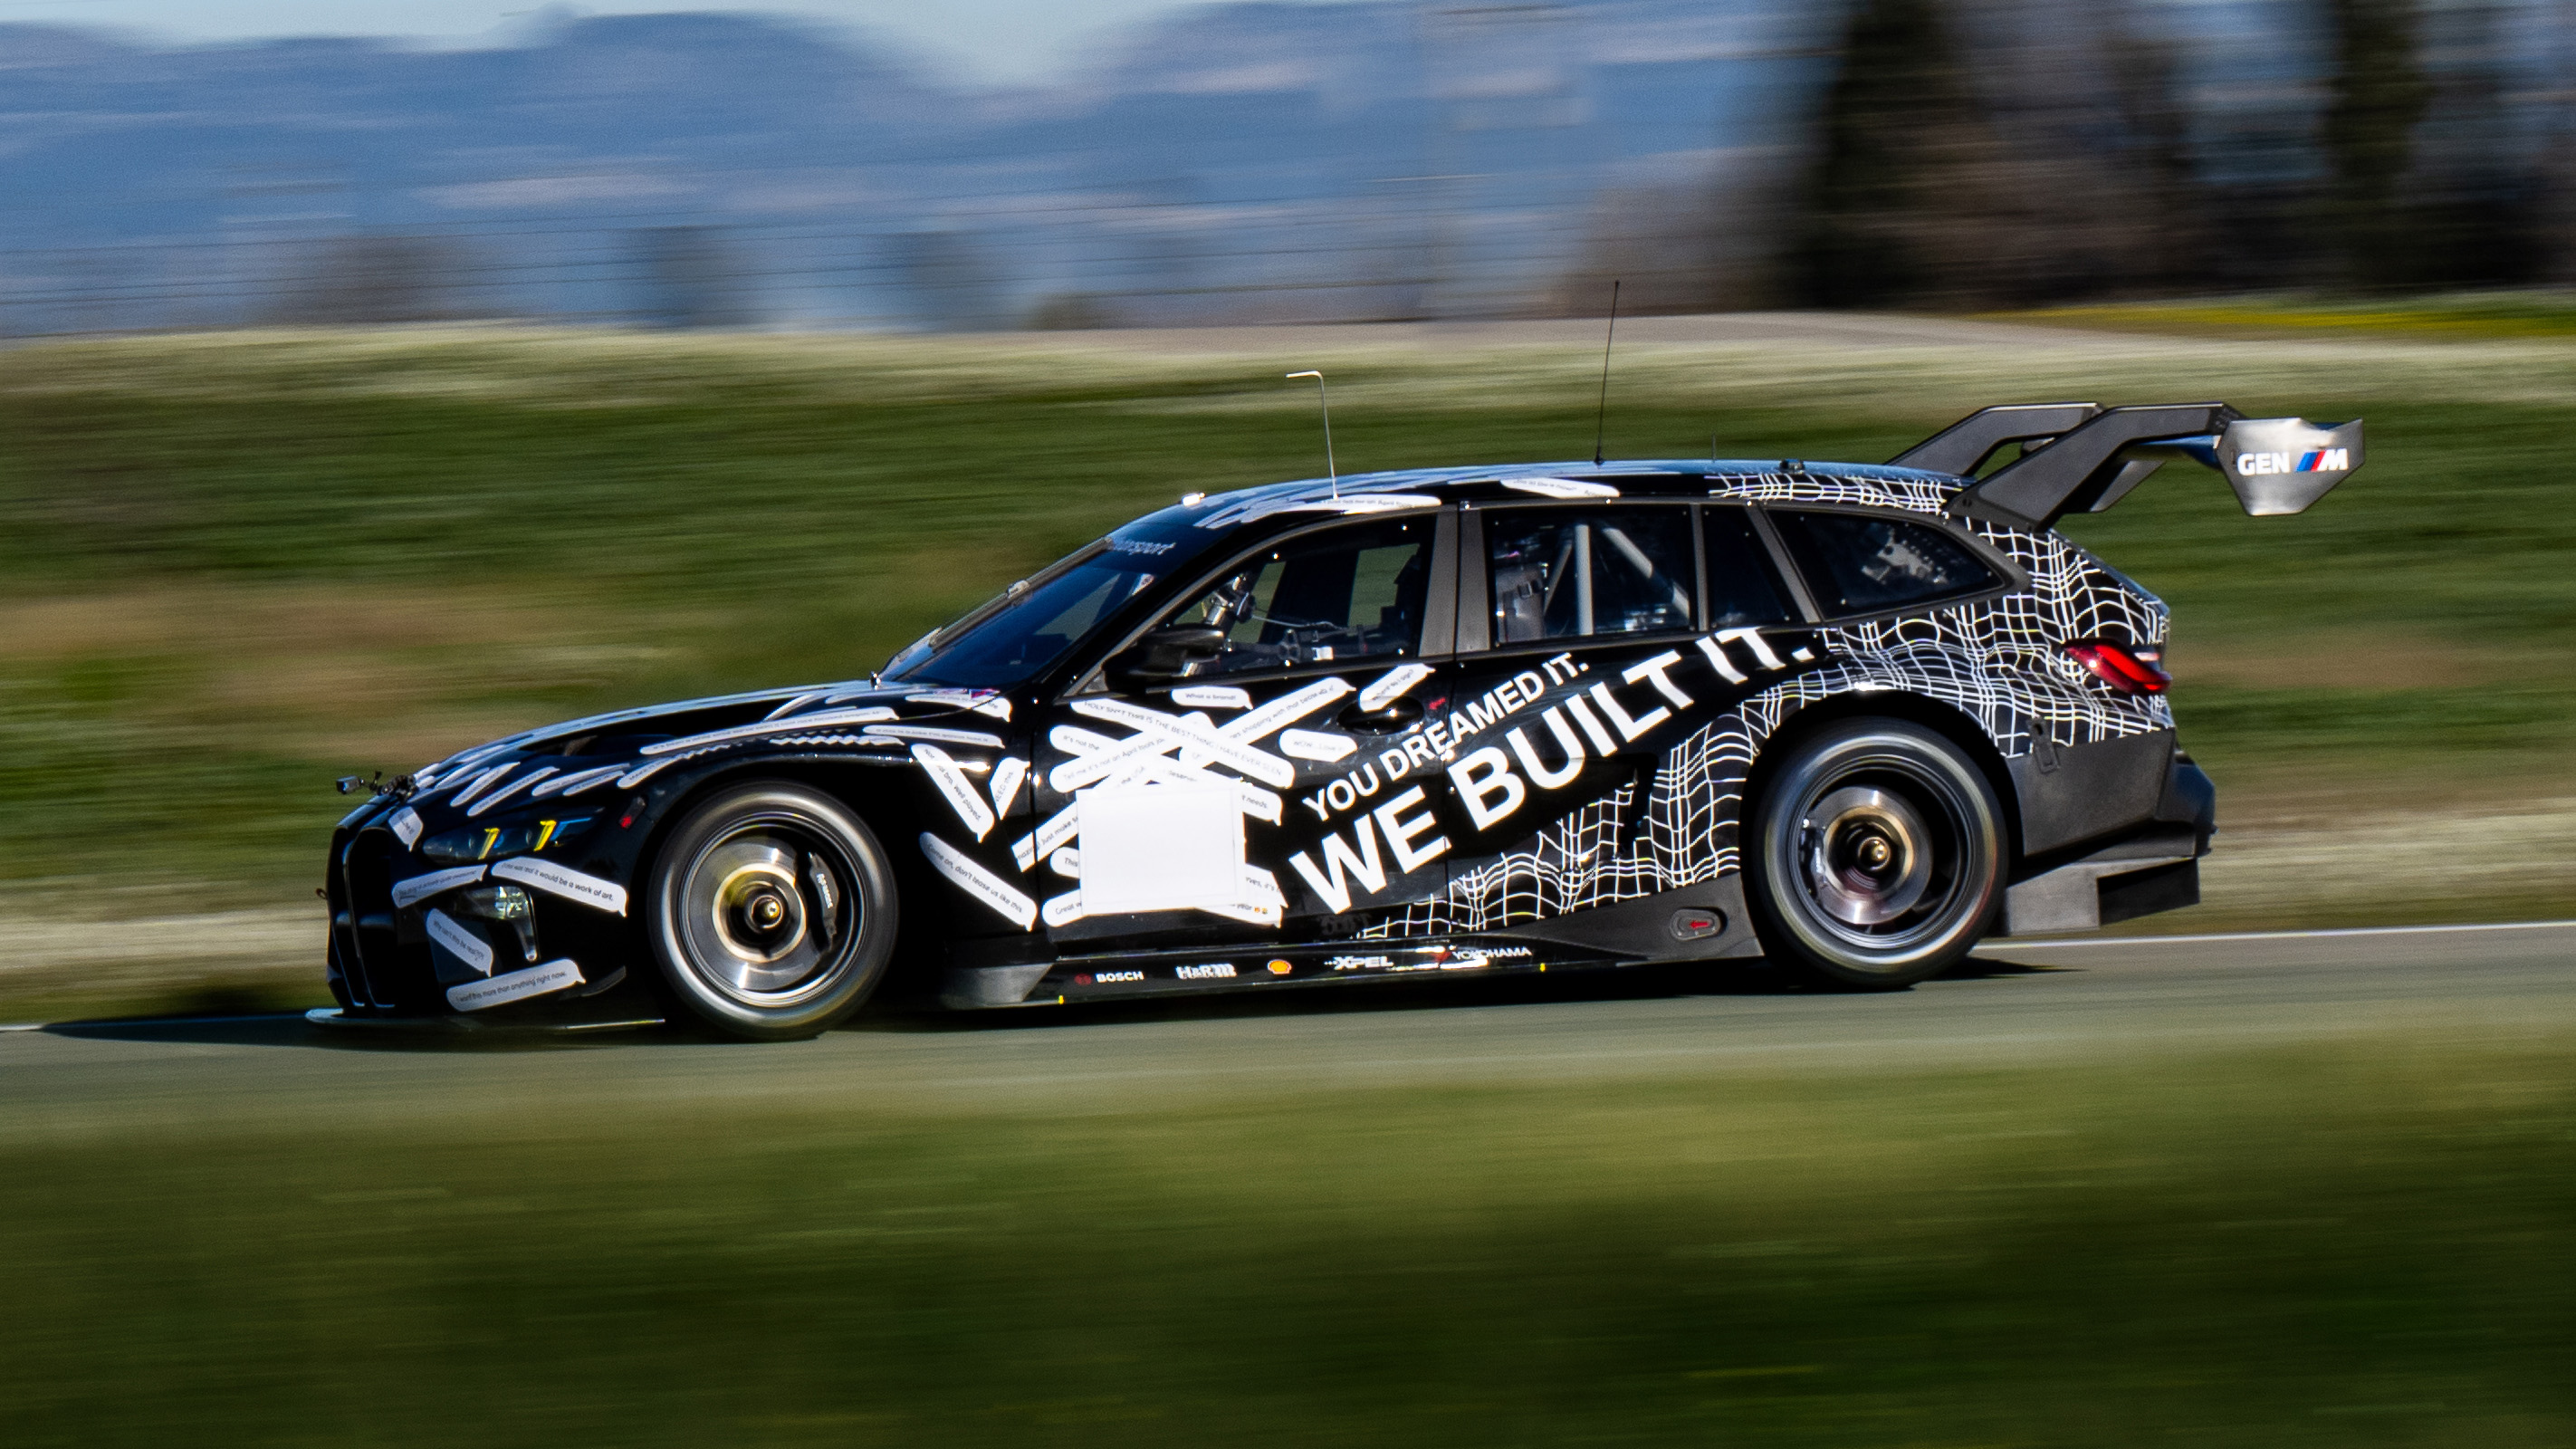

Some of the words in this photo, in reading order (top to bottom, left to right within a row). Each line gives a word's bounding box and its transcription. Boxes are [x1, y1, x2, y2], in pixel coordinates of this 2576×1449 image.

[2236, 451, 2291, 475] GEN
[1272, 708, 1285, 718] with
[1286, 701, 1299, 711] that
[1084, 701, 1104, 710] HOLY
[1145, 715, 1153, 724] IS
[1155, 719, 1169, 729] THE
[1171, 725, 1191, 736] BEST
[1220, 746, 1239, 757] HAVE
[1240, 753, 1261, 766] EVER
[1302, 764, 1380, 822] YOU
[1381, 672, 1546, 782] DREAMED
[1540, 651, 1590, 687] IT.
[1087, 743, 1100, 751] the
[1122, 747, 1137, 757] April
[1003, 772, 1014, 783] this
[1288, 785, 1451, 916] WE
[1449, 648, 1695, 831] BUILT
[1695, 626, 1815, 685] IT.
[953, 785, 966, 799] Well
[1040, 832, 1055, 846] Just
[1054, 820, 1072, 835] make
[1064, 857, 1078, 868] This
[926, 842, 944, 860] Come
[943, 858, 953, 869] on,
[954, 866, 972, 879] don't
[972, 876, 991, 891] tease
[999, 894, 1010, 905] like
[1010, 901, 1022, 913] this
[539, 871, 559, 882] would
[559, 877, 568, 886] be
[574, 884, 592, 894] work
[601, 892, 613, 901] art.
[1055, 903, 1075, 915] Great
[1451, 946, 1533, 961] YOKOHAMA
[1335, 955, 1390, 970] XPEL
[496, 985, 510, 993] than
[511, 977, 536, 991] anything
[536, 974, 551, 984] right
[1095, 971, 1144, 984] BOSCH
